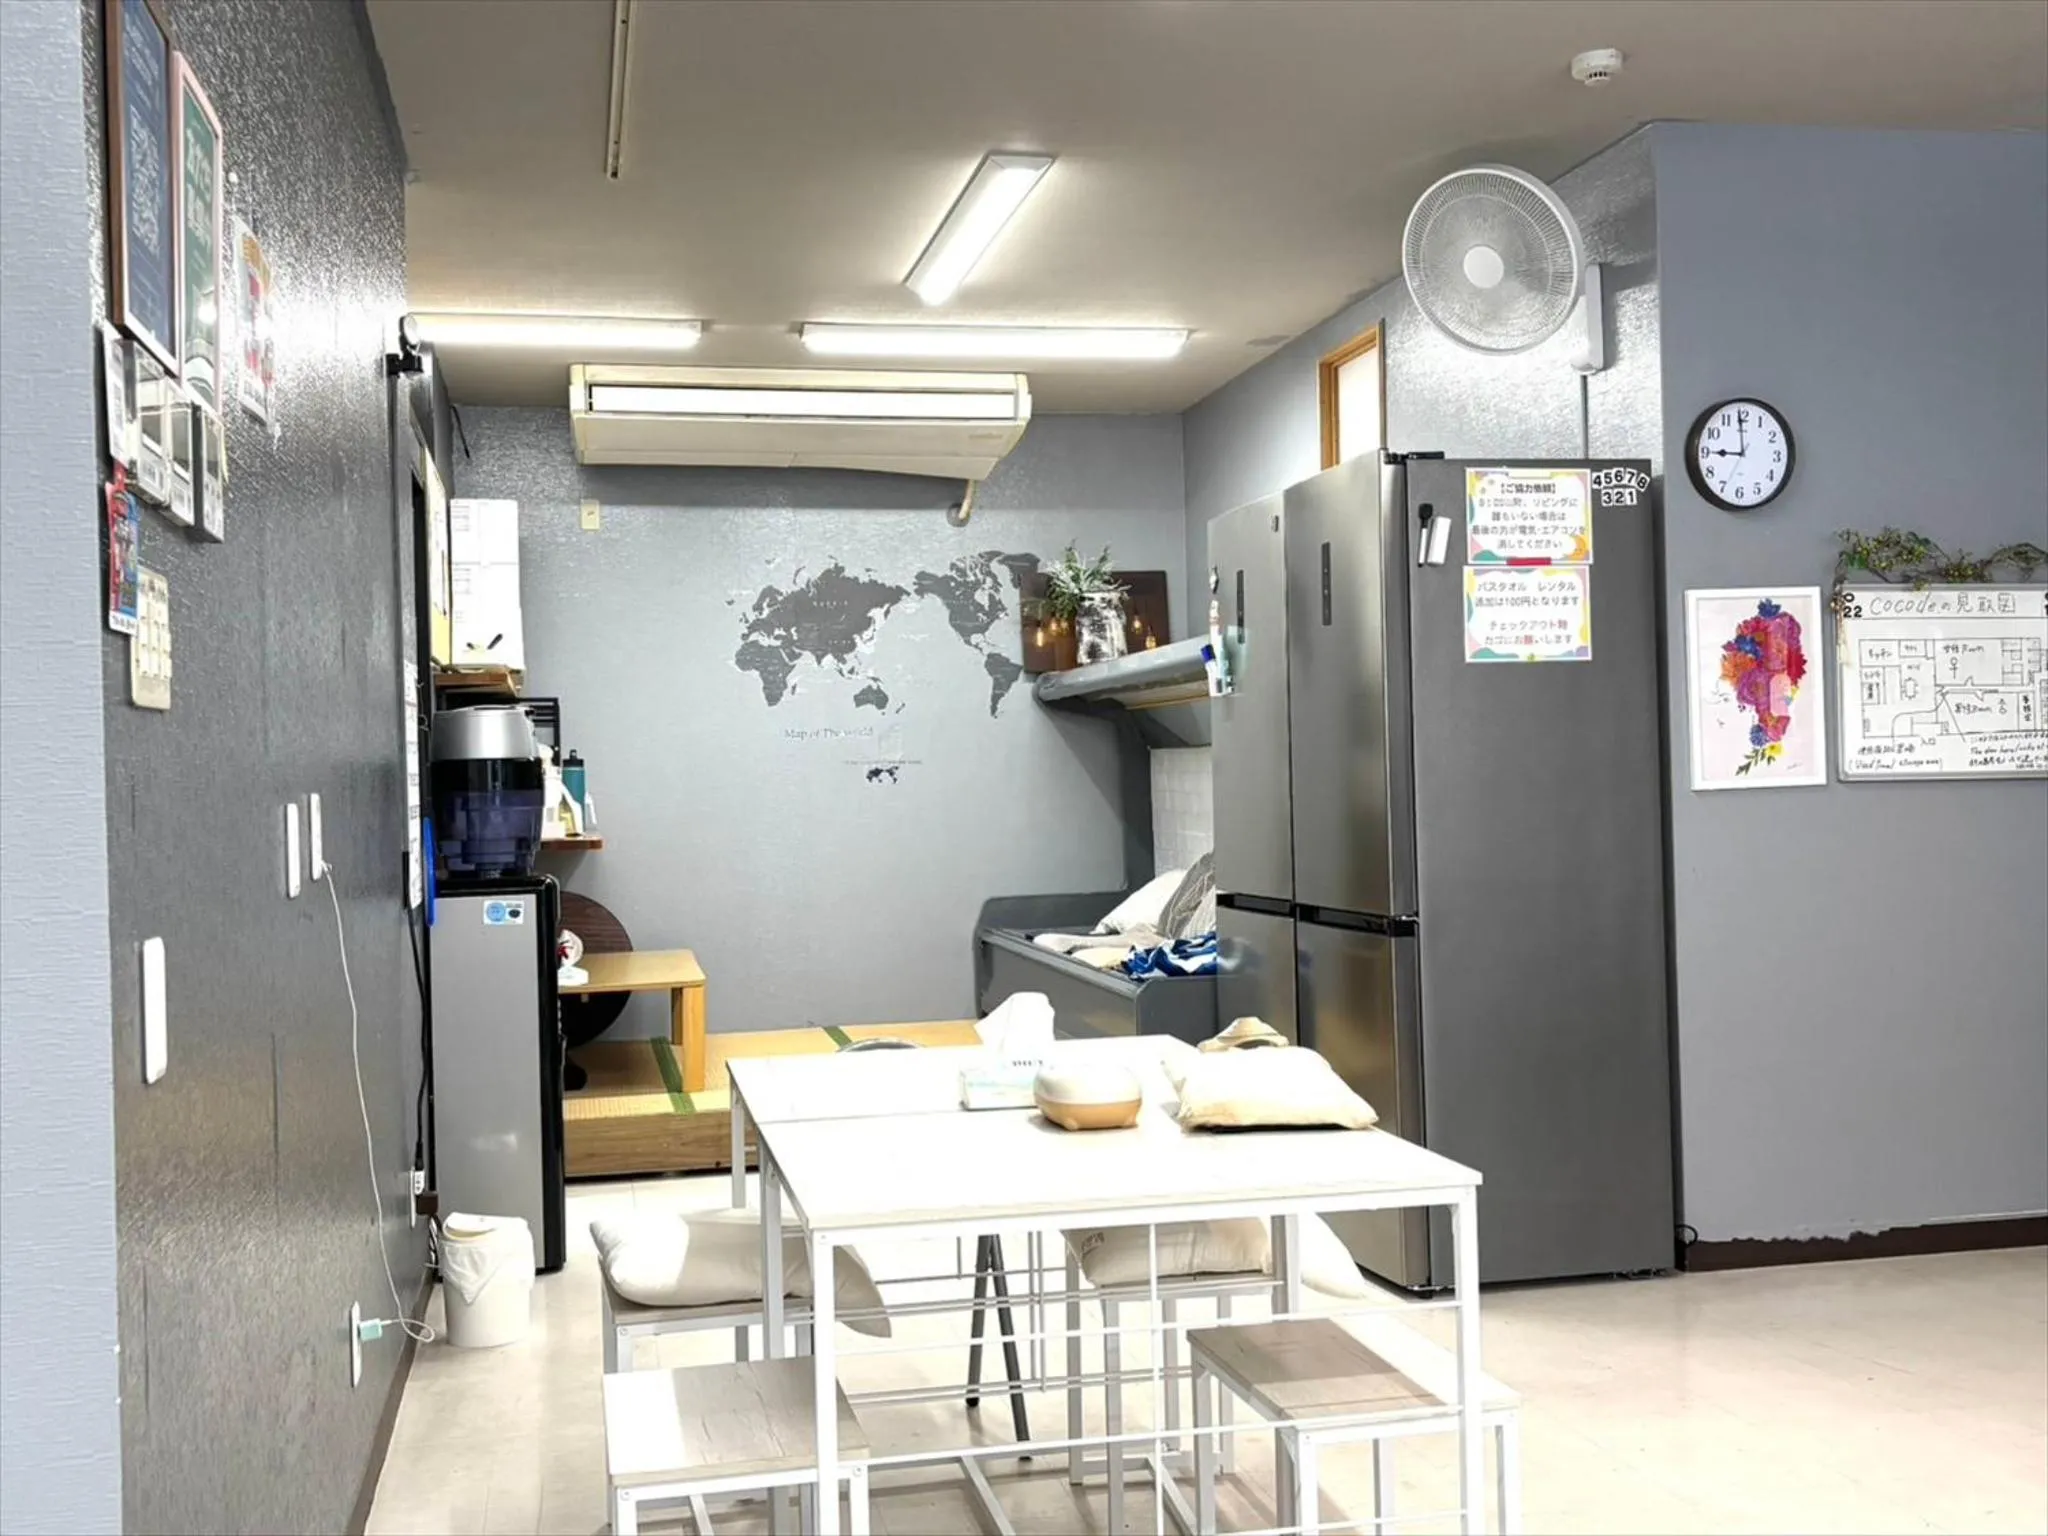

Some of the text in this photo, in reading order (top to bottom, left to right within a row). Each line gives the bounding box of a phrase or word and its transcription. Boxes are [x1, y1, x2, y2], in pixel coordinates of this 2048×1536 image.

[1722, 414, 1731, 427] 11
[1758, 415, 1763, 428] 1
[1707, 427, 1720, 440] 10
[1768, 430, 1777, 443] 2
[1701, 446, 1710, 459] 9
[1773, 450, 1781, 463] 3
[1706, 465, 1715, 479] 8
[1766, 469, 1774, 482] 4
[1719, 480, 1727, 493] 7
[1735, 487, 1745, 499] 6
[1753, 482, 1762, 495] 5
[1537, 581, 1576, 592] レンタル
